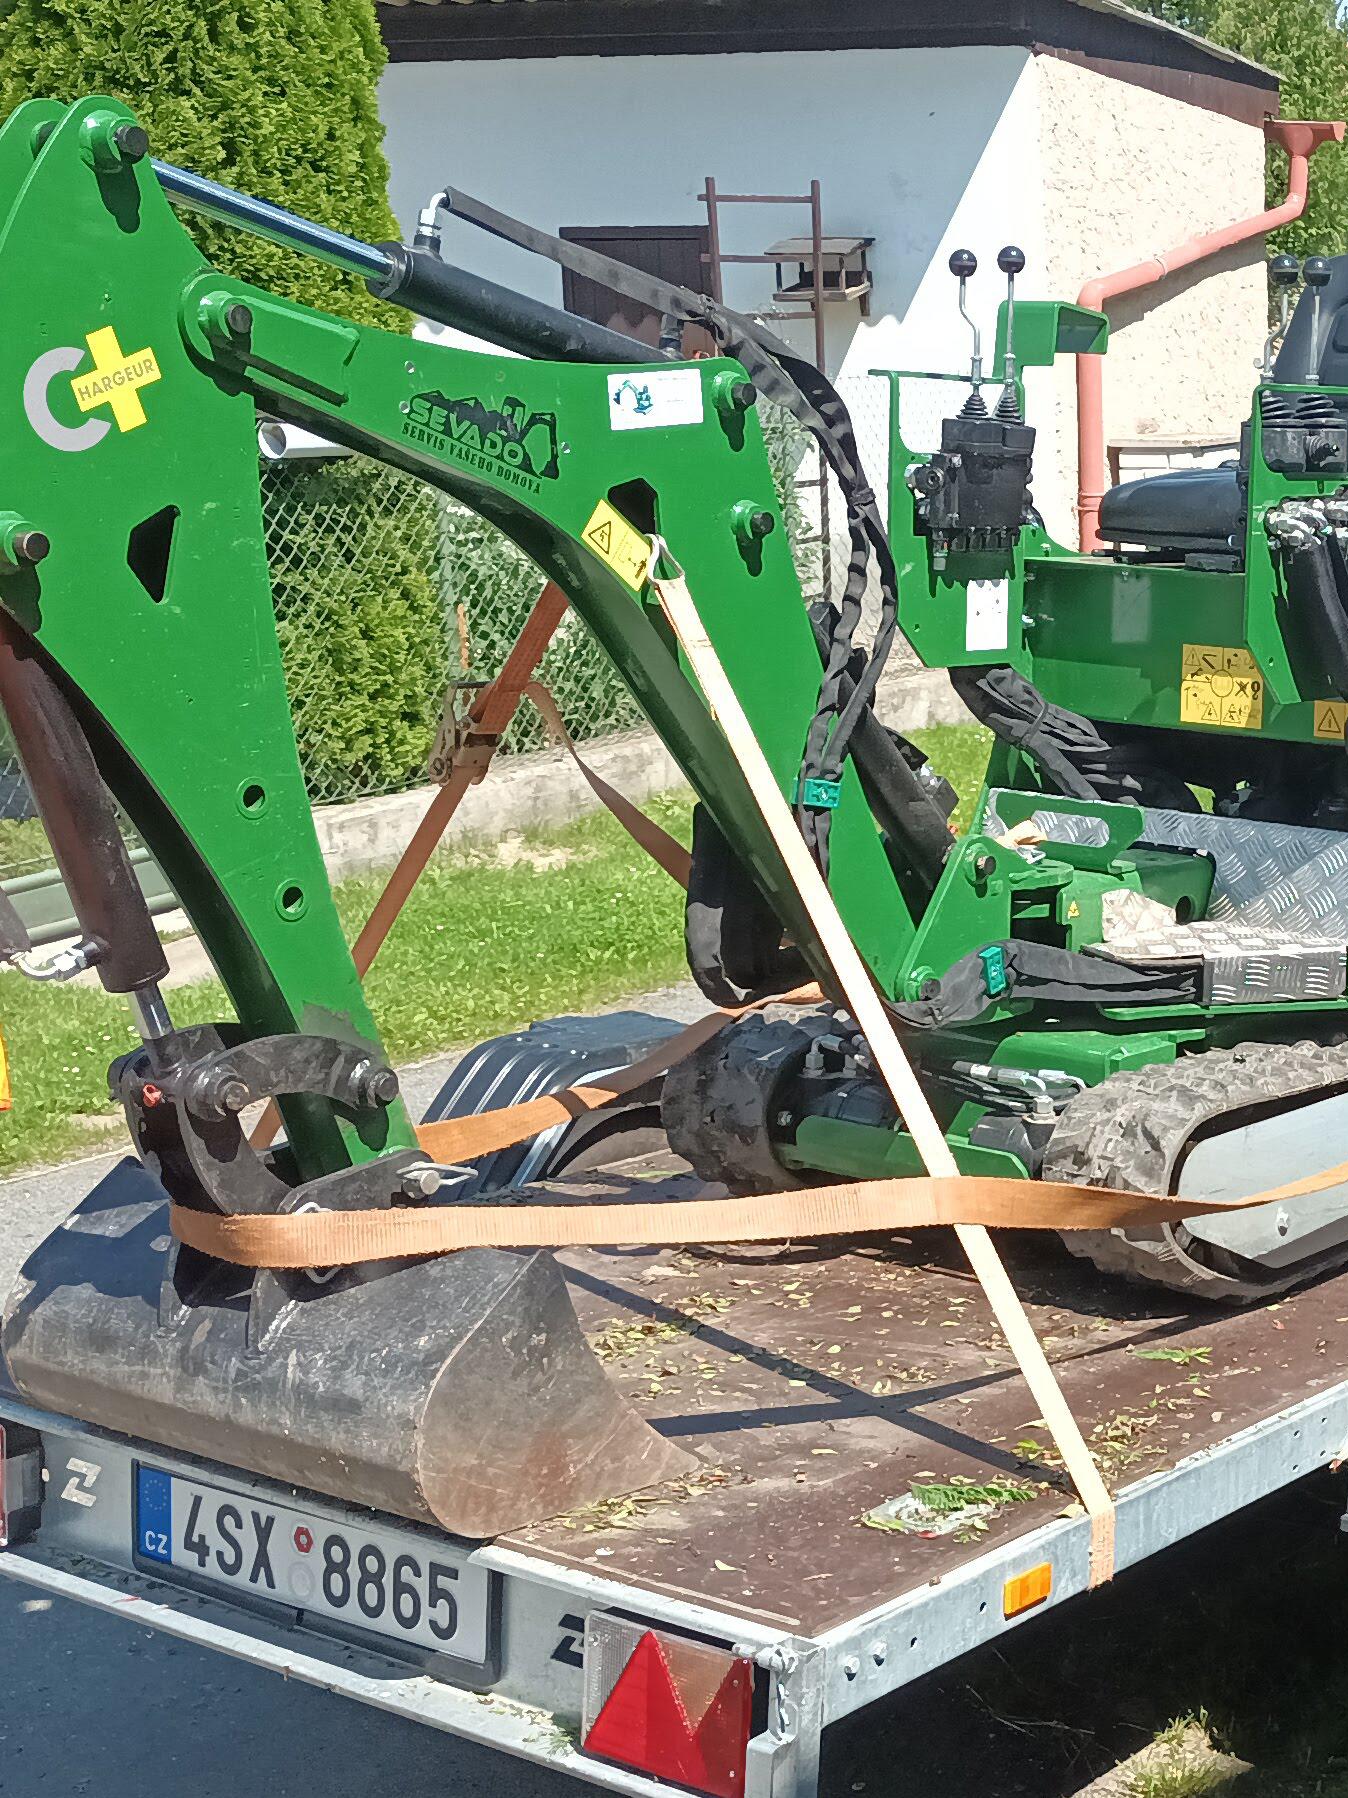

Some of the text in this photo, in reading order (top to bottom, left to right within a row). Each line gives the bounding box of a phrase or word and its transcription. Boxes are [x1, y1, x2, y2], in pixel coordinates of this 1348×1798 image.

[77, 358, 155, 402] HARGEUR
[402, 422, 446, 451] SERVIS
[495, 464, 541, 494] DOMOVA
[407, 398, 524, 466] SEVADO
[144, 1494, 459, 1641] CZ 4SX 8865
